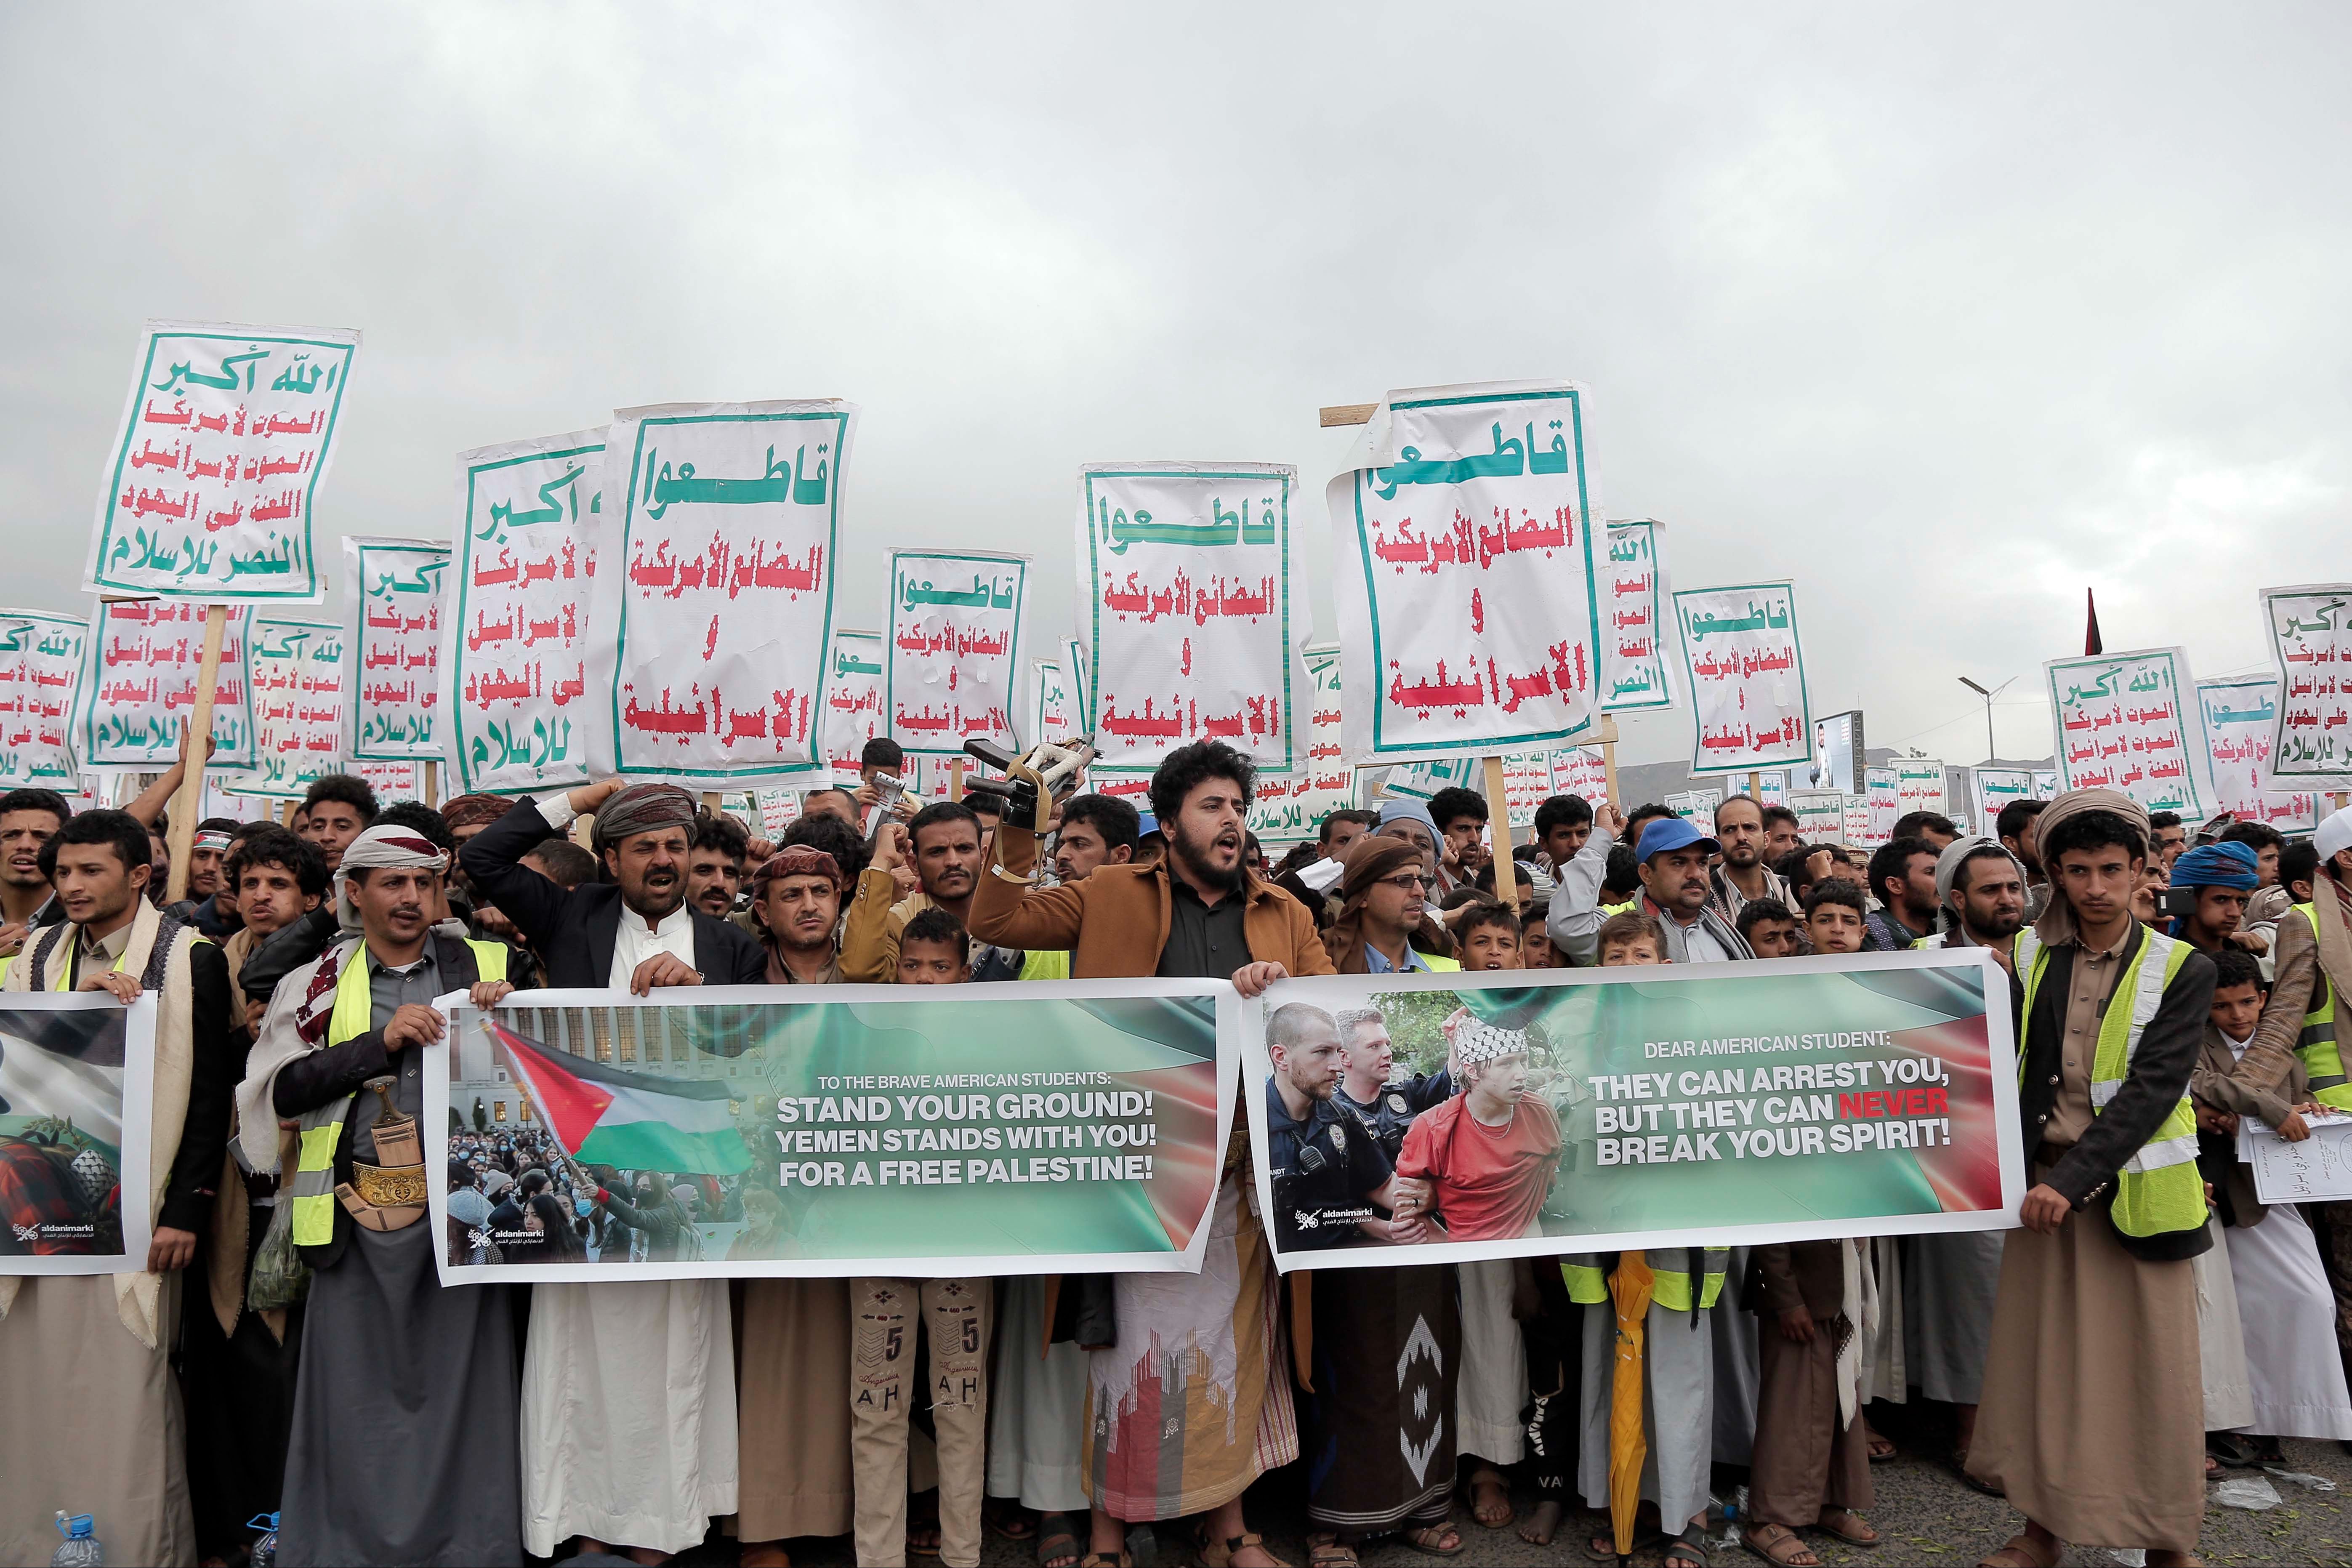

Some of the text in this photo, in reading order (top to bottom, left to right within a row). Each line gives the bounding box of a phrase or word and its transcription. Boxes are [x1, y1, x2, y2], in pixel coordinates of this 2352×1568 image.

[153, 345, 337, 396] الله أكبر
[144, 400, 325, 438] الموت لأمريكا
[244, 451, 314, 484] الموت
[643, 442, 828, 520] قاطعوا
[121, 485, 199, 523] اليهود
[250, 490, 301, 522] اللعنة
[476, 460, 585, 546] أكبر
[1099, 495, 1275, 555] قاطعوا
[1372, 506, 1573, 575] البضائع الأمريكية
[112, 527, 301, 584] النصر للإسلام
[475, 535, 576, 589] لأمريكا
[629, 527, 730, 599] الأمريكية
[366, 555, 450, 602] أكبر
[899, 570, 1014, 612] قاطعوا
[1104, 564, 1274, 626] البضائع الأمريكية
[1471, 588, 1484, 635] و
[1684, 601, 1788, 642] قاطعوا
[2280, 599, 2346, 642] أكبر
[37, 628, 81, 657] الله
[702, 615, 718, 661] و
[897, 620, 955, 657] الأمريكية
[1181, 638, 1192, 676] و
[1692, 643, 1793, 680] البضائع الأمريكية
[31, 668, 74, 689] الموت
[101, 677, 158, 708] اليهود
[364, 681, 415, 707] اليهود
[465, 659, 541, 711] اليهود
[949, 666, 957, 691] و
[1610, 665, 1658, 700] النصر
[2064, 664, 2169, 708] الله أكبر
[299, 703, 341, 725] الموت
[1737, 688, 1744, 710] و
[363, 714, 433, 753] للإسلام
[867, 721, 874, 741] و
[2064, 702, 2174, 732] الموت لأمريكا
[2287, 707, 2322, 729] اليهود
[98, 714, 178, 759] للإسلام
[306, 731, 338, 753] اللعنة
[471, 714, 571, 783] للإسلام
[2132, 731, 2179, 754] الموت
[2280, 736, 2333, 770] للإسلام
[23, 753, 72, 783] النصر
[1256, 770, 1351, 801] اللعنة اليهود
[2121, 761, 2143, 786] على
[2149, 758, 2185, 779] اللعنة
[2251, 767, 2257, 789] و
[1981, 777, 2028, 796] قاطعوا
[1793, 800, 1839, 818] قاطعوا
[1645, 1028, 1891, 1058] DEAR AMERICAN STUDENT:
[819, 1071, 1111, 1089] TO THE BRAVE AMERICAN STUDENTS:
[1588, 1057, 1948, 1100] THEY CAN ARREST YOU,
[777, 1091, 1152, 1122] STAND YOUR GROUND!
[1596, 1088, 1948, 1133] BUT THEY CAN NEVER
[775, 1124, 1155, 1152] YEMEN STANDS WITH YOU!
[1597, 1118, 1950, 1165] BREAK YOUR SPIRIT!
[780, 1155, 1152, 1186] FOR A FREE PALESTINE!
[1322, 1208, 1373, 1218] aldanimarki
[885, 1326, 903, 1362] 5
[962, 1318, 979, 1353] 5
